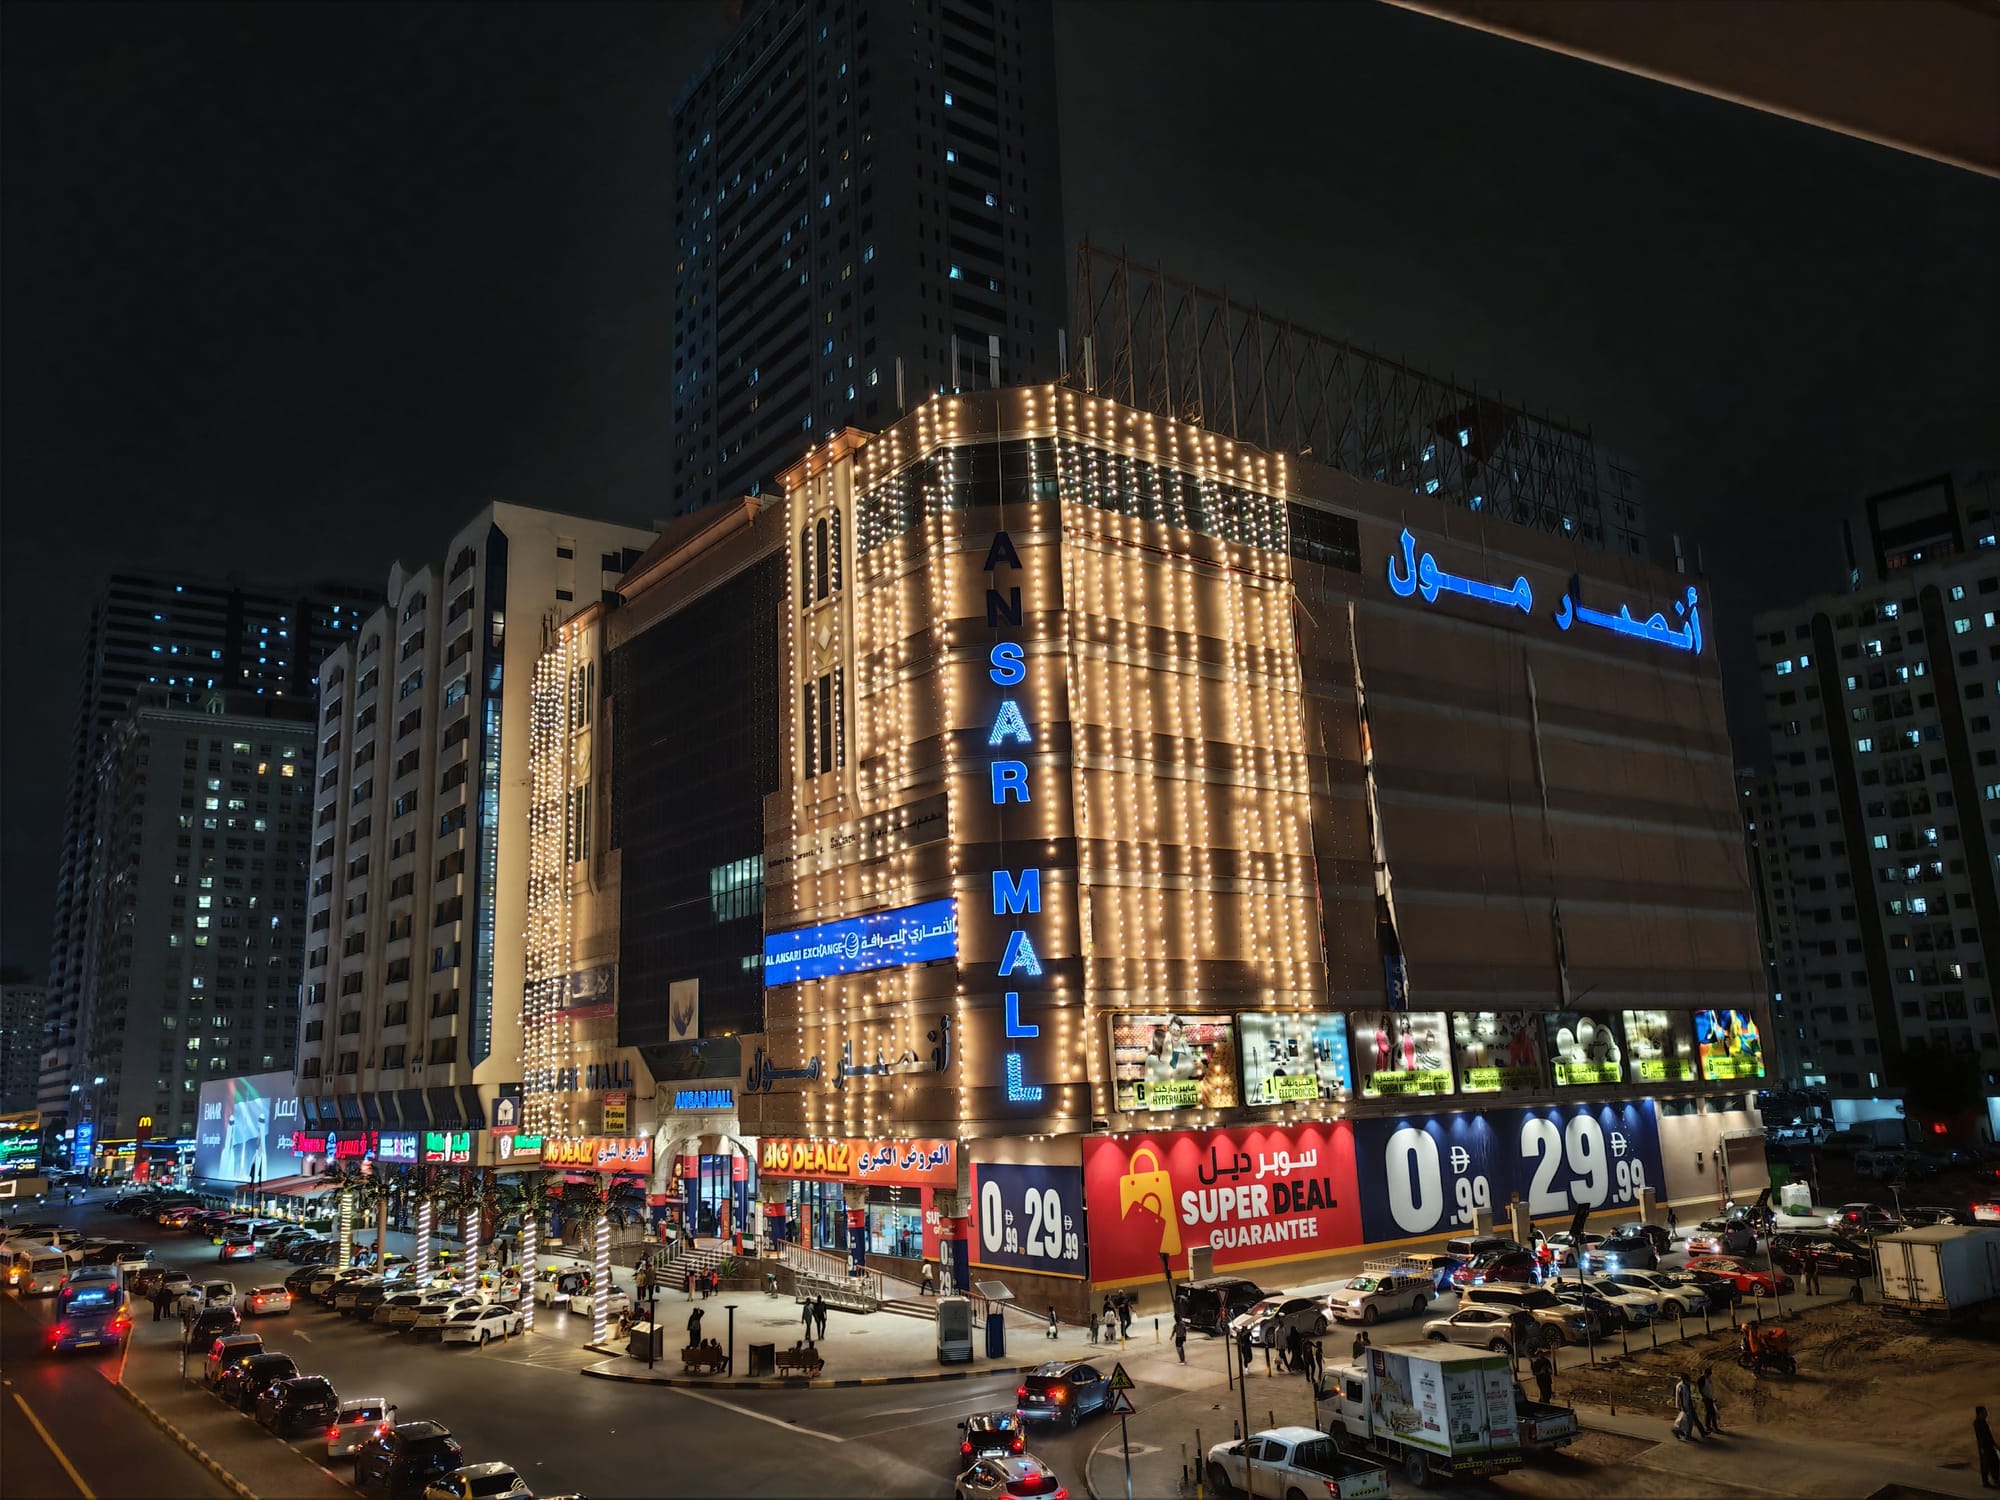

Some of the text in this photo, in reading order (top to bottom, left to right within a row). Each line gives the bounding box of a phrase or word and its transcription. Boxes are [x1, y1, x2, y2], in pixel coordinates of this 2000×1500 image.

[1389, 528, 1703, 655] أنصار مول
[984, 531, 1042, 1101] ANSAR MALL
[765, 941, 843, 966] AL ANSARI EXCHANGE
[585, 1059, 632, 1090] MALL
[746, 1049, 820, 1092] مول
[1464, 1070, 1471, 1085] 3
[1641, 1062, 1648, 1076] 5
[1708, 1060, 1714, 1073] 6
[1137, 1083, 1145, 1101] G
[1266, 1078, 1272, 1094] 1
[1364, 1074, 1371, 1089] 2
[675, 1089, 734, 1109] ANSAR MALL
[1152, 1093, 1198, 1105] HYPERMARKET
[543, 1140, 559, 1162] BIG
[560, 1140, 593, 1164] DEALZ
[762, 1142, 850, 1173] BIG DEALZ
[901, 1144, 951, 1172] العروض
[1198, 1146, 1318, 1185] سوبر ديل
[1521, 1114, 1609, 1216] 29
[1181, 1177, 1338, 1225] SUPER DEAL
[1024, 1187, 1063, 1259] 29
[1209, 1217, 1319, 1250] GUARANTEE
